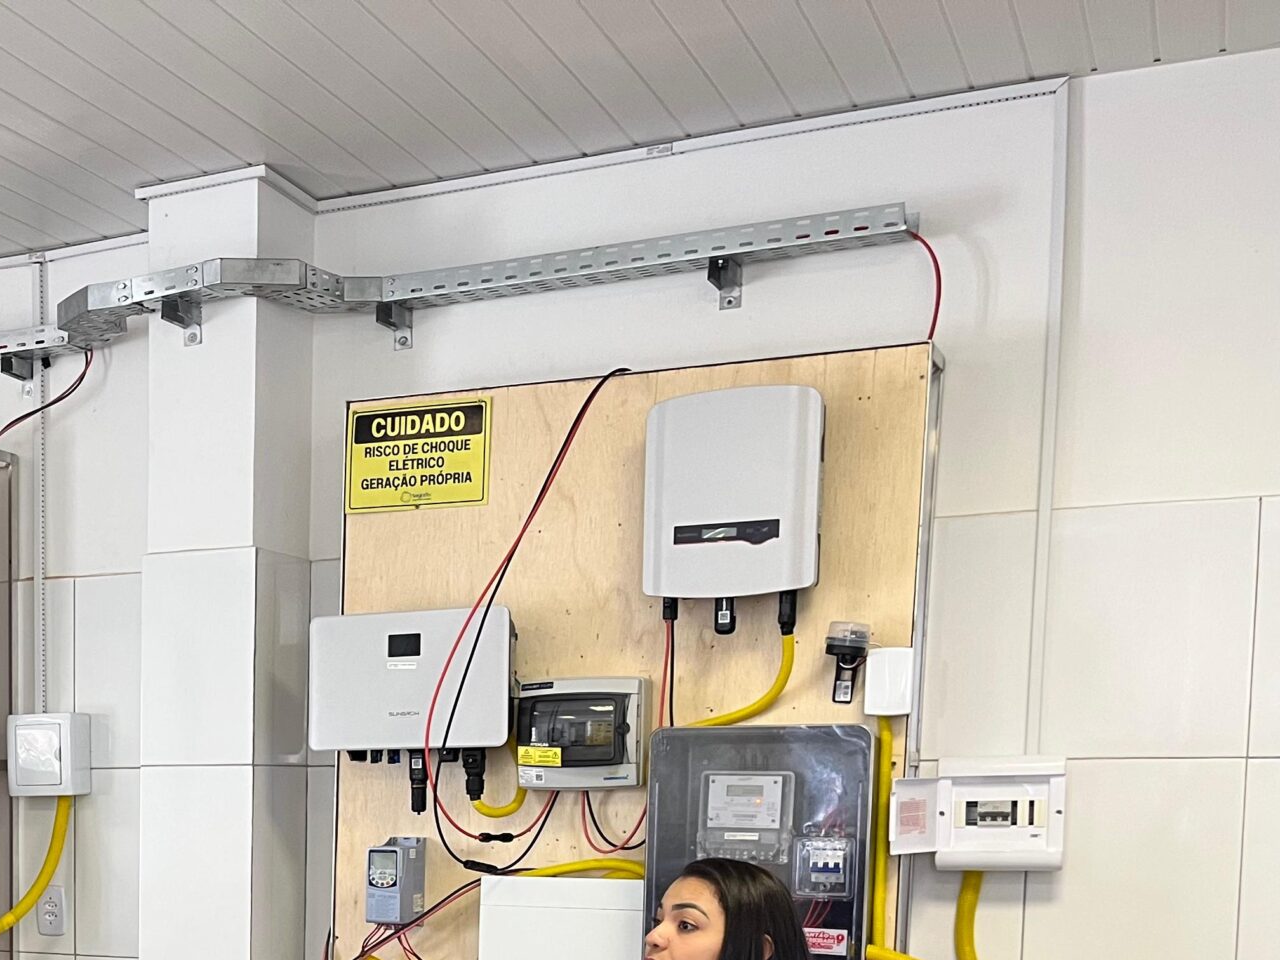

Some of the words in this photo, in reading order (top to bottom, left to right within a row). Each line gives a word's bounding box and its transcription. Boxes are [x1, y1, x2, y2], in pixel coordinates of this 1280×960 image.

[371, 410, 466, 438] CUIDADO
[364, 444, 400, 459] RISCO
[403, 442, 419, 456] DE
[421, 438, 471, 454] CHOQUE
[388, 455, 445, 472] ELÉTRICO
[361, 473, 417, 491] GERAÇÃO
[420, 470, 473, 487] PRÓPRIA
